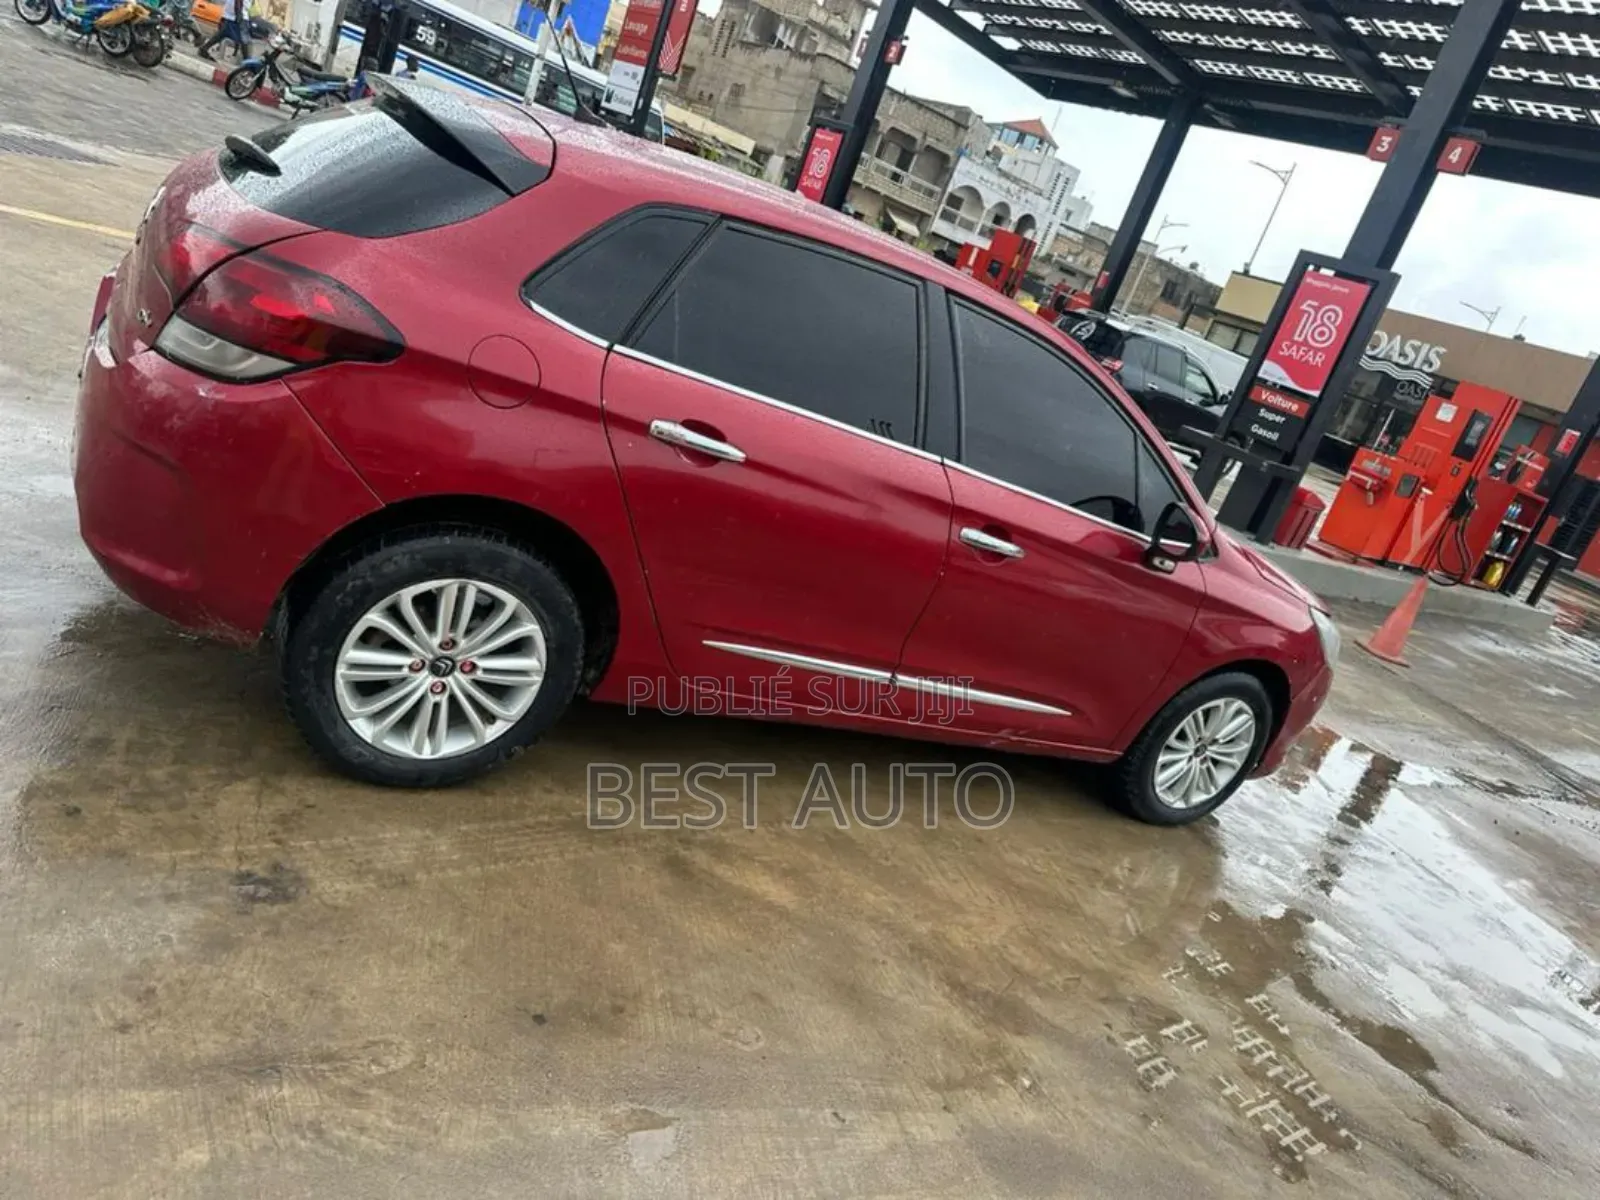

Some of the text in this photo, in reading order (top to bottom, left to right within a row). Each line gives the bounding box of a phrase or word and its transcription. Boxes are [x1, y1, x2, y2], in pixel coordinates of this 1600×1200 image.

[415, 26, 436, 44] 59
[1376, 136, 1392, 152] 3
[1447, 146, 1463, 163] 4
[1295, 301, 1343, 348] 18
[1279, 342, 1326, 367] SAFAR
[1366, 331, 1447, 372] OASIS
[1261, 391, 1298, 411] Voiture
[1259, 408, 1286, 424] Super
[1252, 425, 1279, 440] Gasoil
